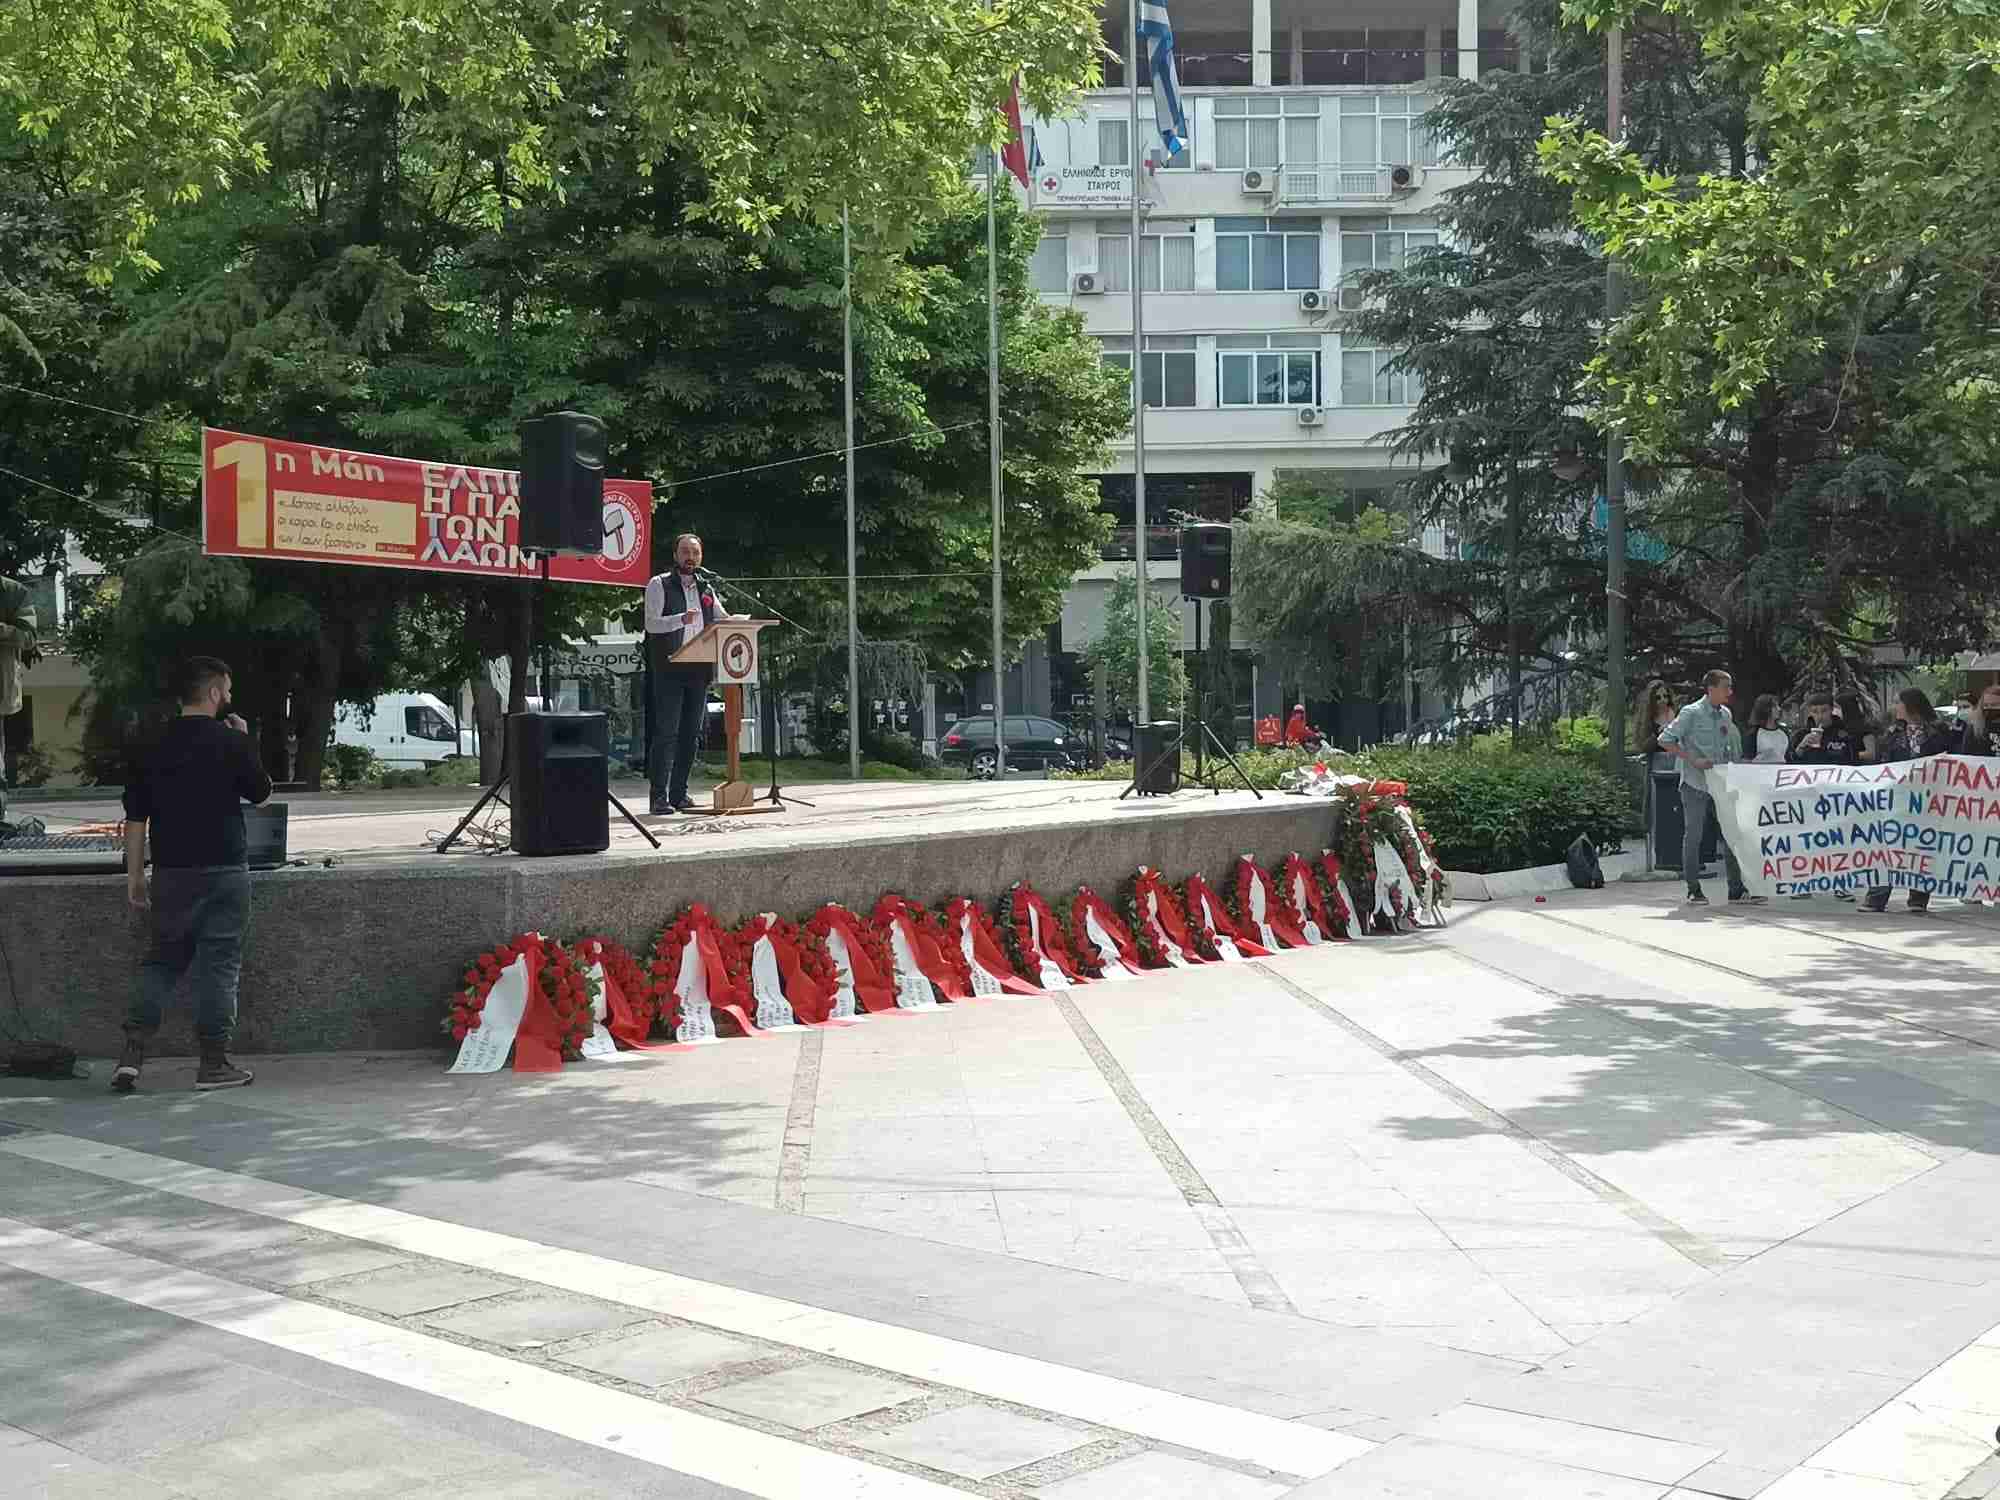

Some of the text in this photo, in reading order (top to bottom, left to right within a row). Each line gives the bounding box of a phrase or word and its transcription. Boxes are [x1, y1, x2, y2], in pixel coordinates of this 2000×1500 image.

[1087, 181, 1121, 191] ΣΤΑΥΡΟΣ
[310, 450, 385, 482] Μάη
[420, 511, 505, 544] ΤΩΝ
[420, 538, 536, 570] ΛΑΩΝ
[1758, 799, 1804, 827] ΔΕΝ
[1815, 788, 1894, 821] ΦΤΑΝΕΙ
[1760, 835, 1791, 857] ΚΑΙ
[1797, 826, 1845, 851] ΤΟΝ
[1947, 860, 1989, 881] ΓΙΑ
